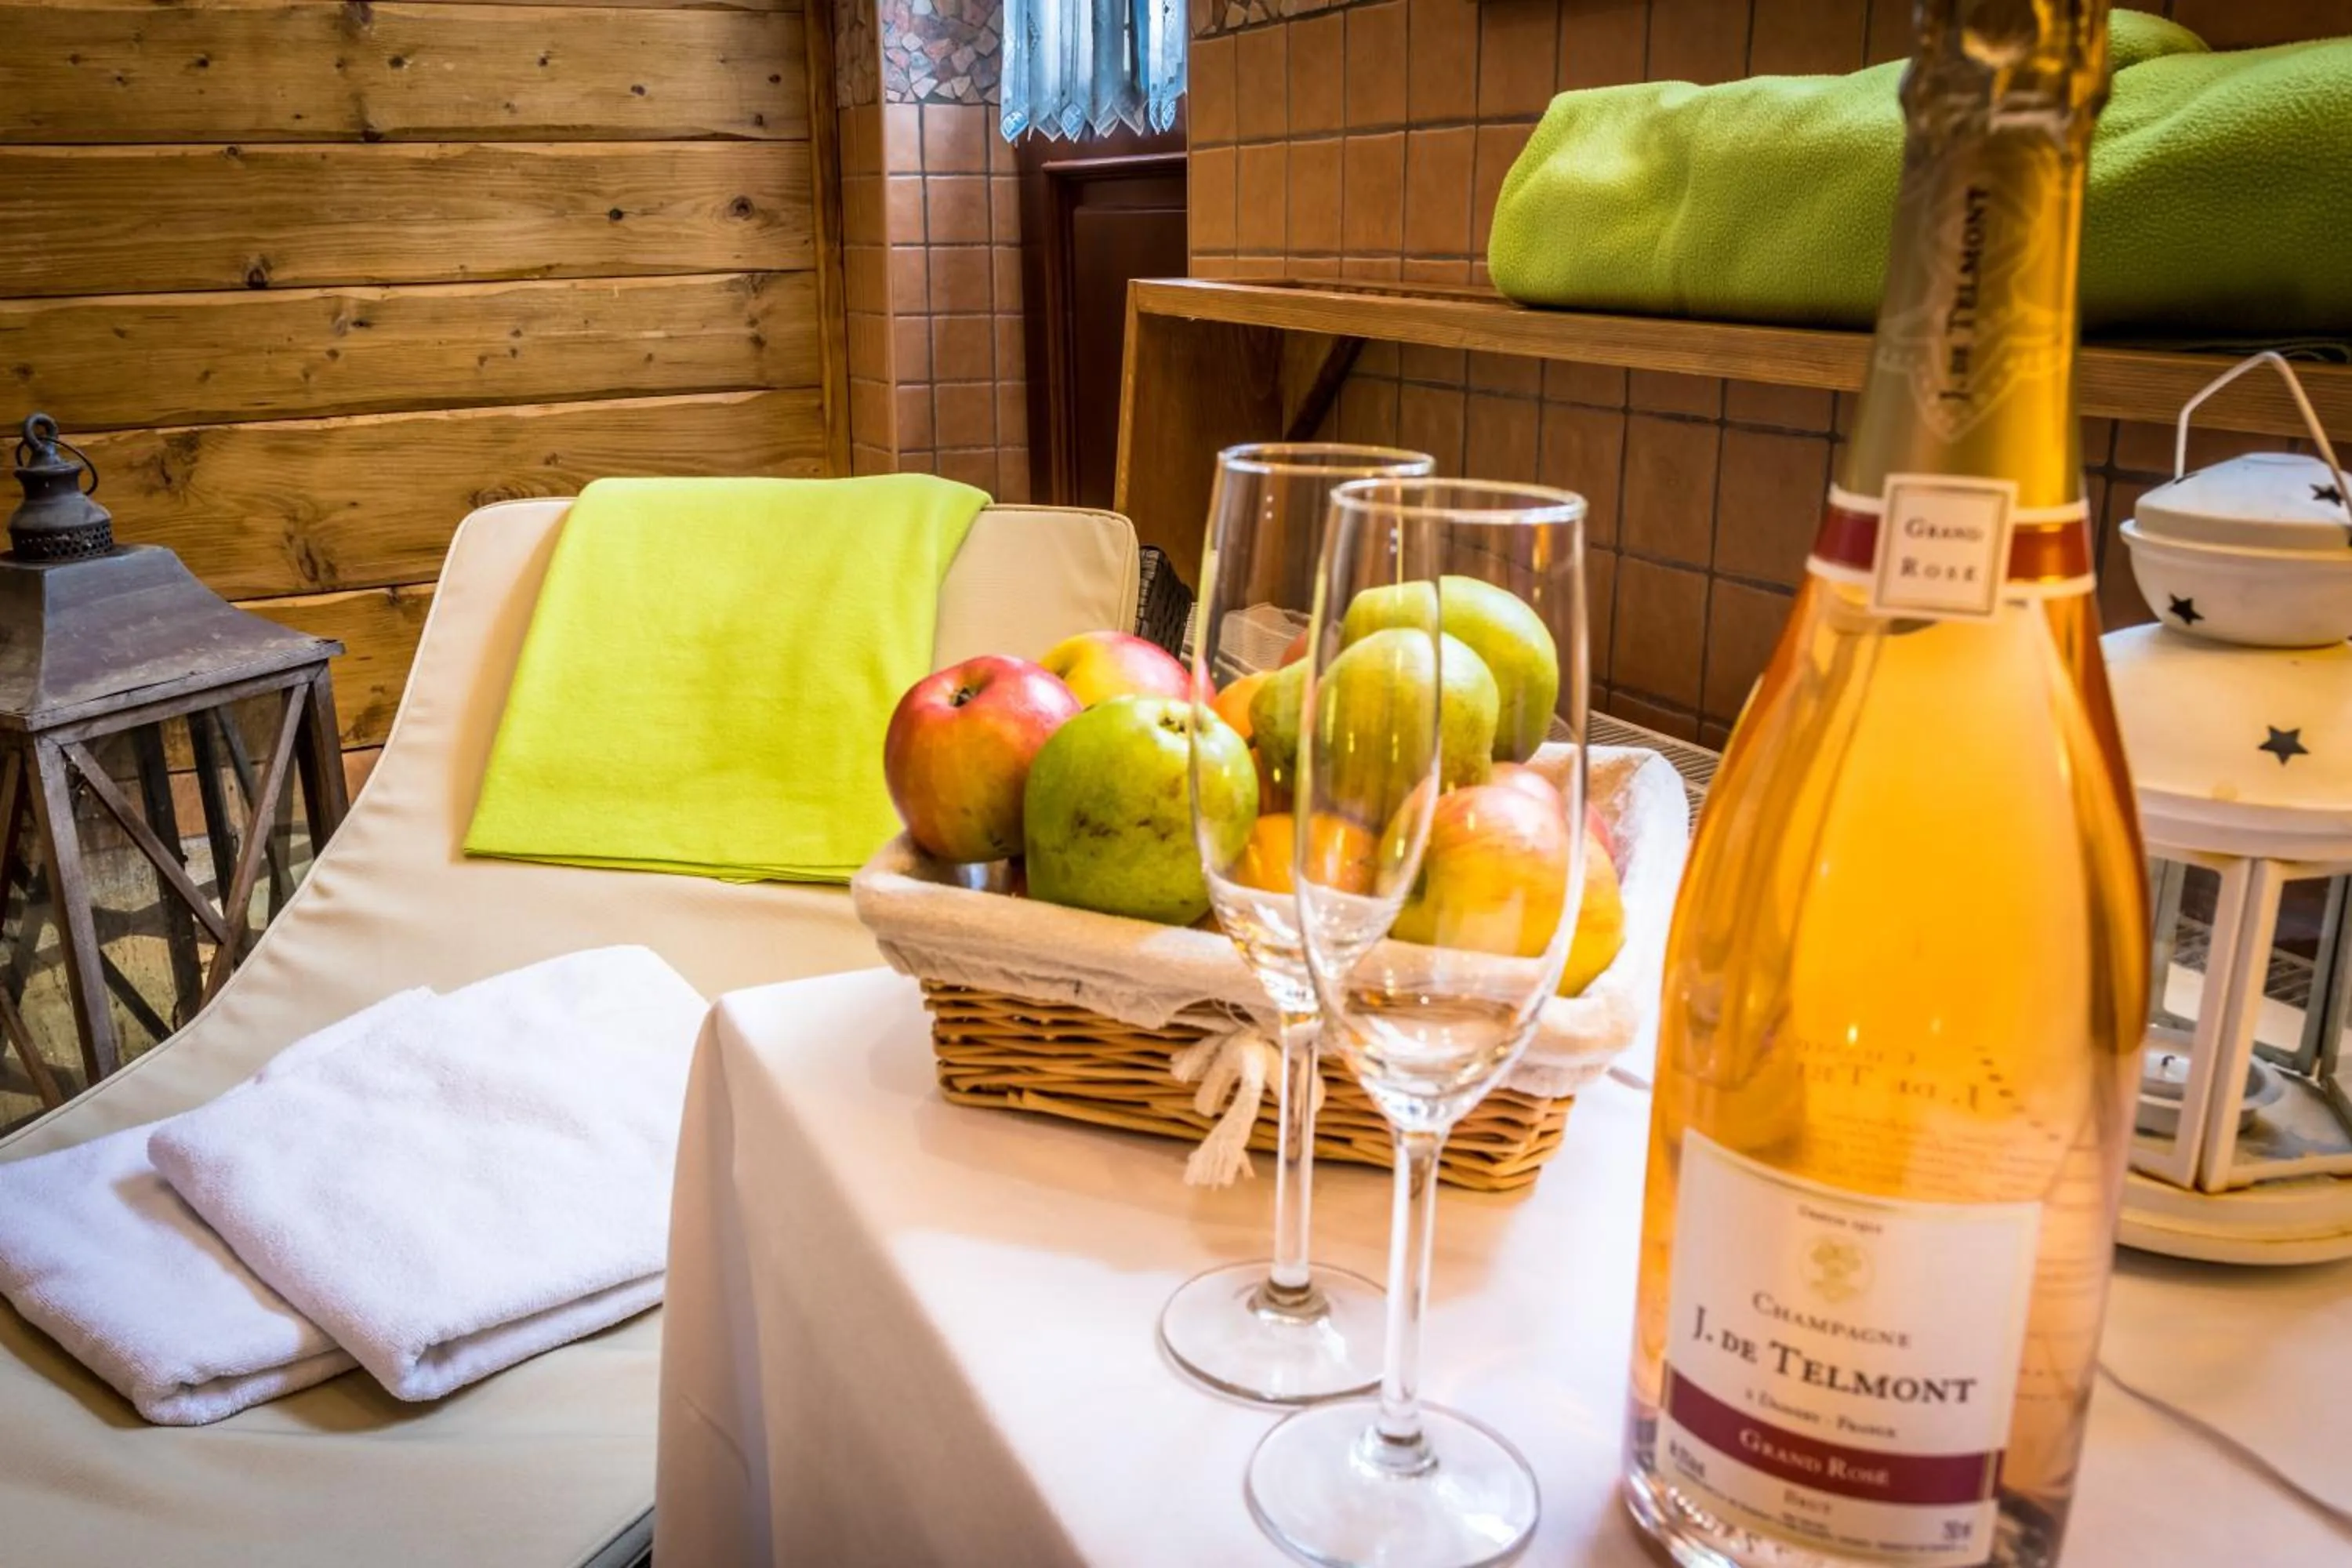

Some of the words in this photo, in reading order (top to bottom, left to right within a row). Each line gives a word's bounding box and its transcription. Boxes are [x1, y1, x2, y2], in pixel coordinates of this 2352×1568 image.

[1946, 186, 1988, 336] TELMONT
[1905, 518, 1984, 543] GRAND
[1752, 1290, 1911, 1348] CHAMPAGNE
[1693, 1304, 1715, 1342] J.
[1720, 1328, 1758, 1363] DE
[1769, 1340, 1976, 1405] TELMONT
[1739, 1427, 1823, 1475] GRAND
